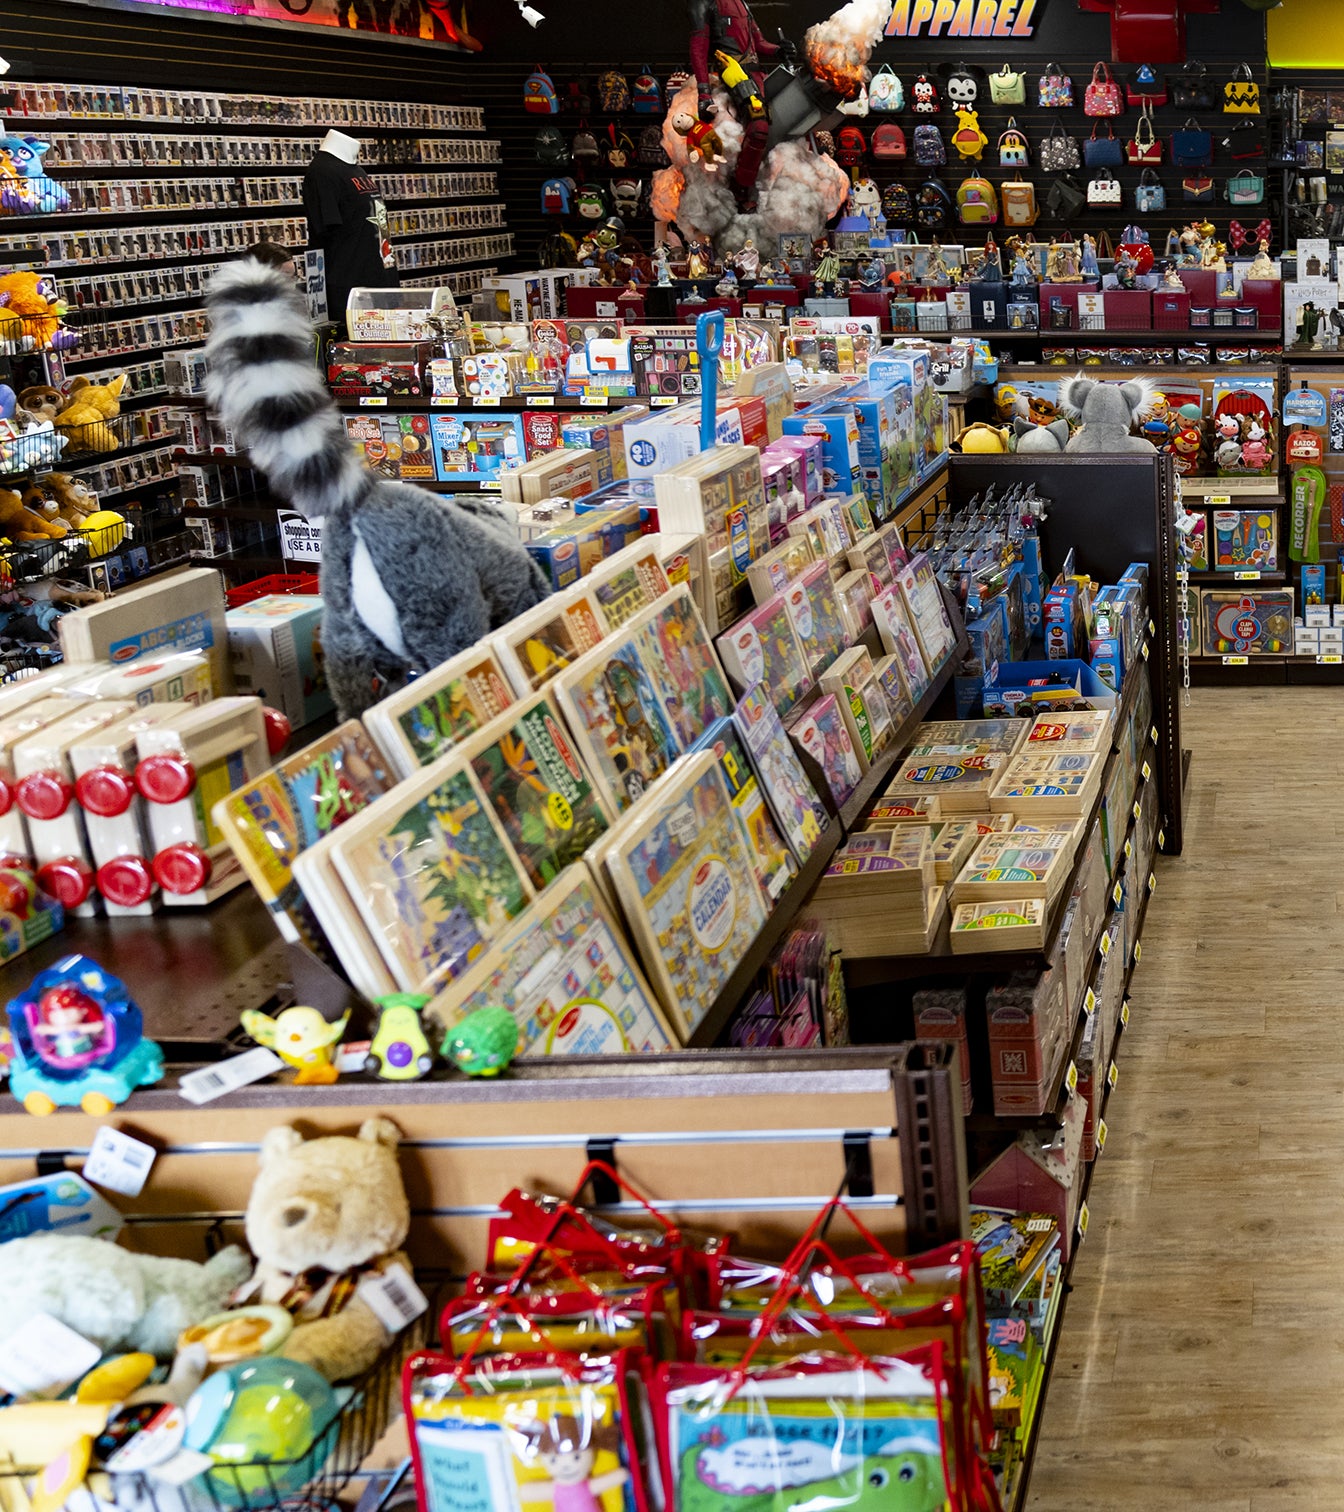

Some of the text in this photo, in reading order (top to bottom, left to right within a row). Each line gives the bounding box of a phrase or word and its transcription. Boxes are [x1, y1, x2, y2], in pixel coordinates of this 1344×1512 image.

[884, 0, 1037, 37] APPAREL
[932, 363, 950, 375] Grill
[438, 431, 460, 441] Mixer
[537, 438, 550, 446] Set
[443, 439, 456, 448] Set
[1293, 485, 1305, 549] RECORDER
[284, 524, 310, 540] shopping
[287, 541, 305, 551] USE
[306, 542, 313, 551] A
[530, 711, 582, 804] WOODEN
[693, 877, 733, 932] CALENDAR
